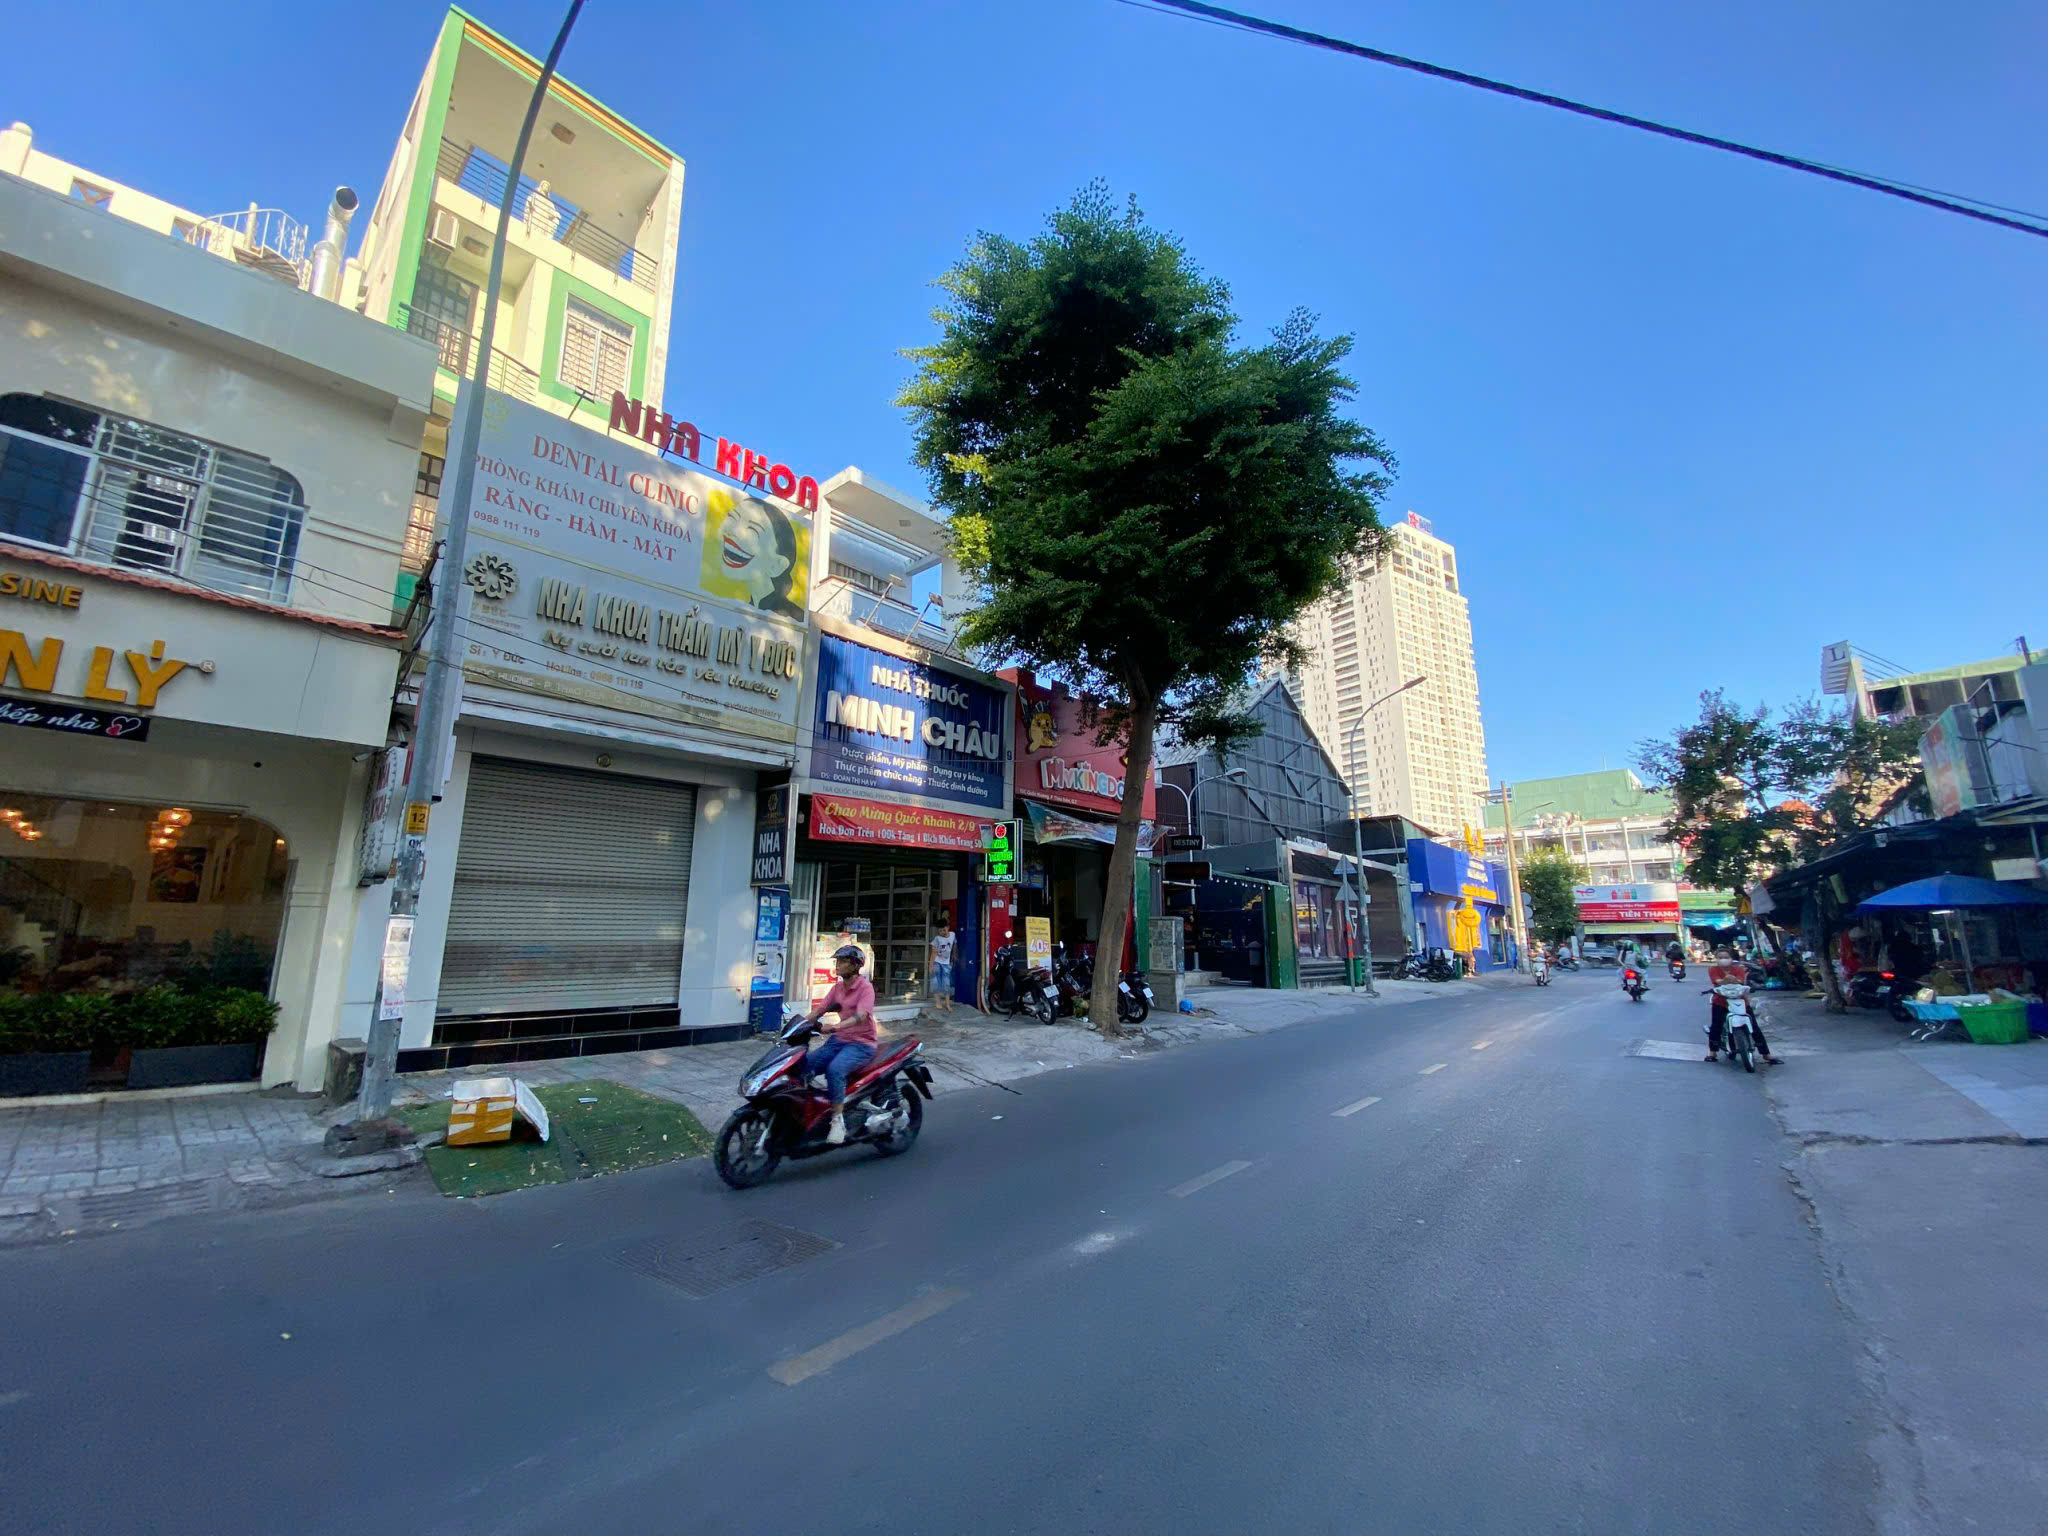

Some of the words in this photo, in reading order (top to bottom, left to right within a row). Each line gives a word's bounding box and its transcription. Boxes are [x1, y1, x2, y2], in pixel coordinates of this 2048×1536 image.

[610, 390, 700, 462] NHA
[716, 436, 819, 511] KHOA
[533, 434, 623, 488] DENTAL
[628, 472, 699, 515] CLINIC
[535, 465, 584, 506] KHÁM
[588, 493, 649, 528] CHUYÊN
[652, 517, 692, 543] KHOA
[473, 510, 499, 526] 0988
[503, 520, 520, 531] 111
[523, 525, 540, 538] 119
[485, 485, 550, 521] RĂNG
[569, 515, 617, 544] HÀM
[634, 535, 677, 563] MẶT
[536, 575, 588, 626] NHA
[594, 590, 649, 642] KHOA
[872, 665, 913, 695] NHÀ
[913, 676, 969, 710] THUỐC
[47, 712, 101, 730] nhà
[826, 690, 915, 743] MINH
[921, 716, 999, 760] CHÂU
[928, 776, 949, 790] Thuốc
[412, 812, 426, 823] 12
[825, 802, 857, 818] Chào
[859, 804, 891, 824] Mừng
[895, 811, 920, 827] Quốc
[923, 814, 955, 830] Khánh
[759, 831, 780, 854] NHA
[1174, 839, 1200, 847] DESTINY
[754, 857, 782, 879] KHOA
